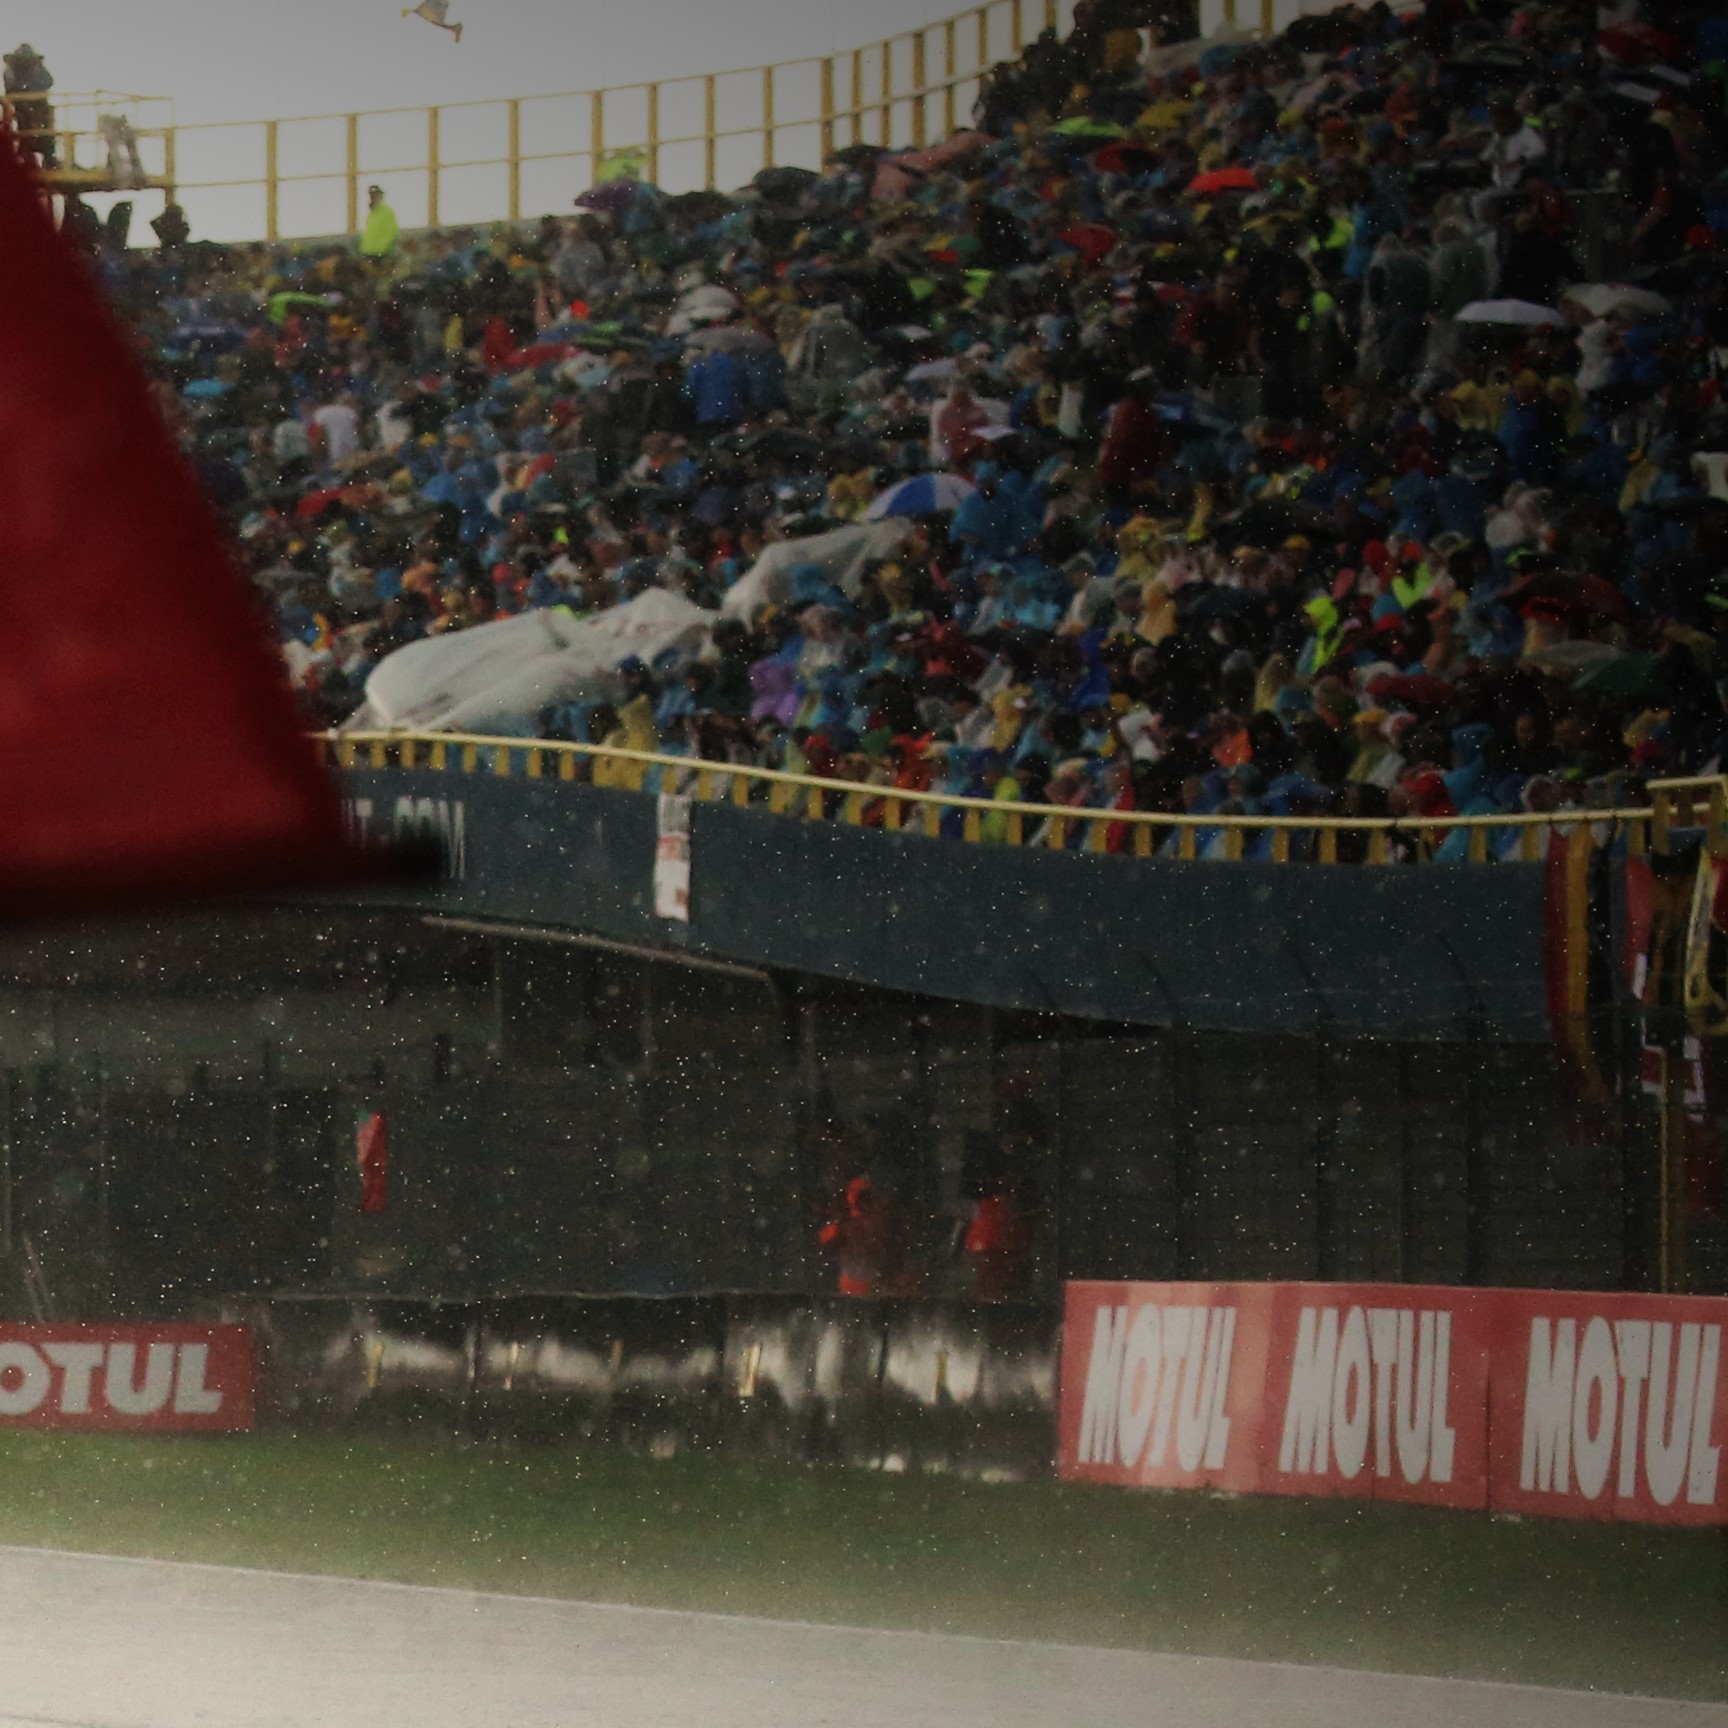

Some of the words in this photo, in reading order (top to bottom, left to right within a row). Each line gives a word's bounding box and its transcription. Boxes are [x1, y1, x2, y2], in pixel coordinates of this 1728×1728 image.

[1077, 1303, 1236, 1471] MOTUL
[1278, 1304, 1456, 1483] MOTUL
[1520, 1314, 1722, 1506] MOTUL
